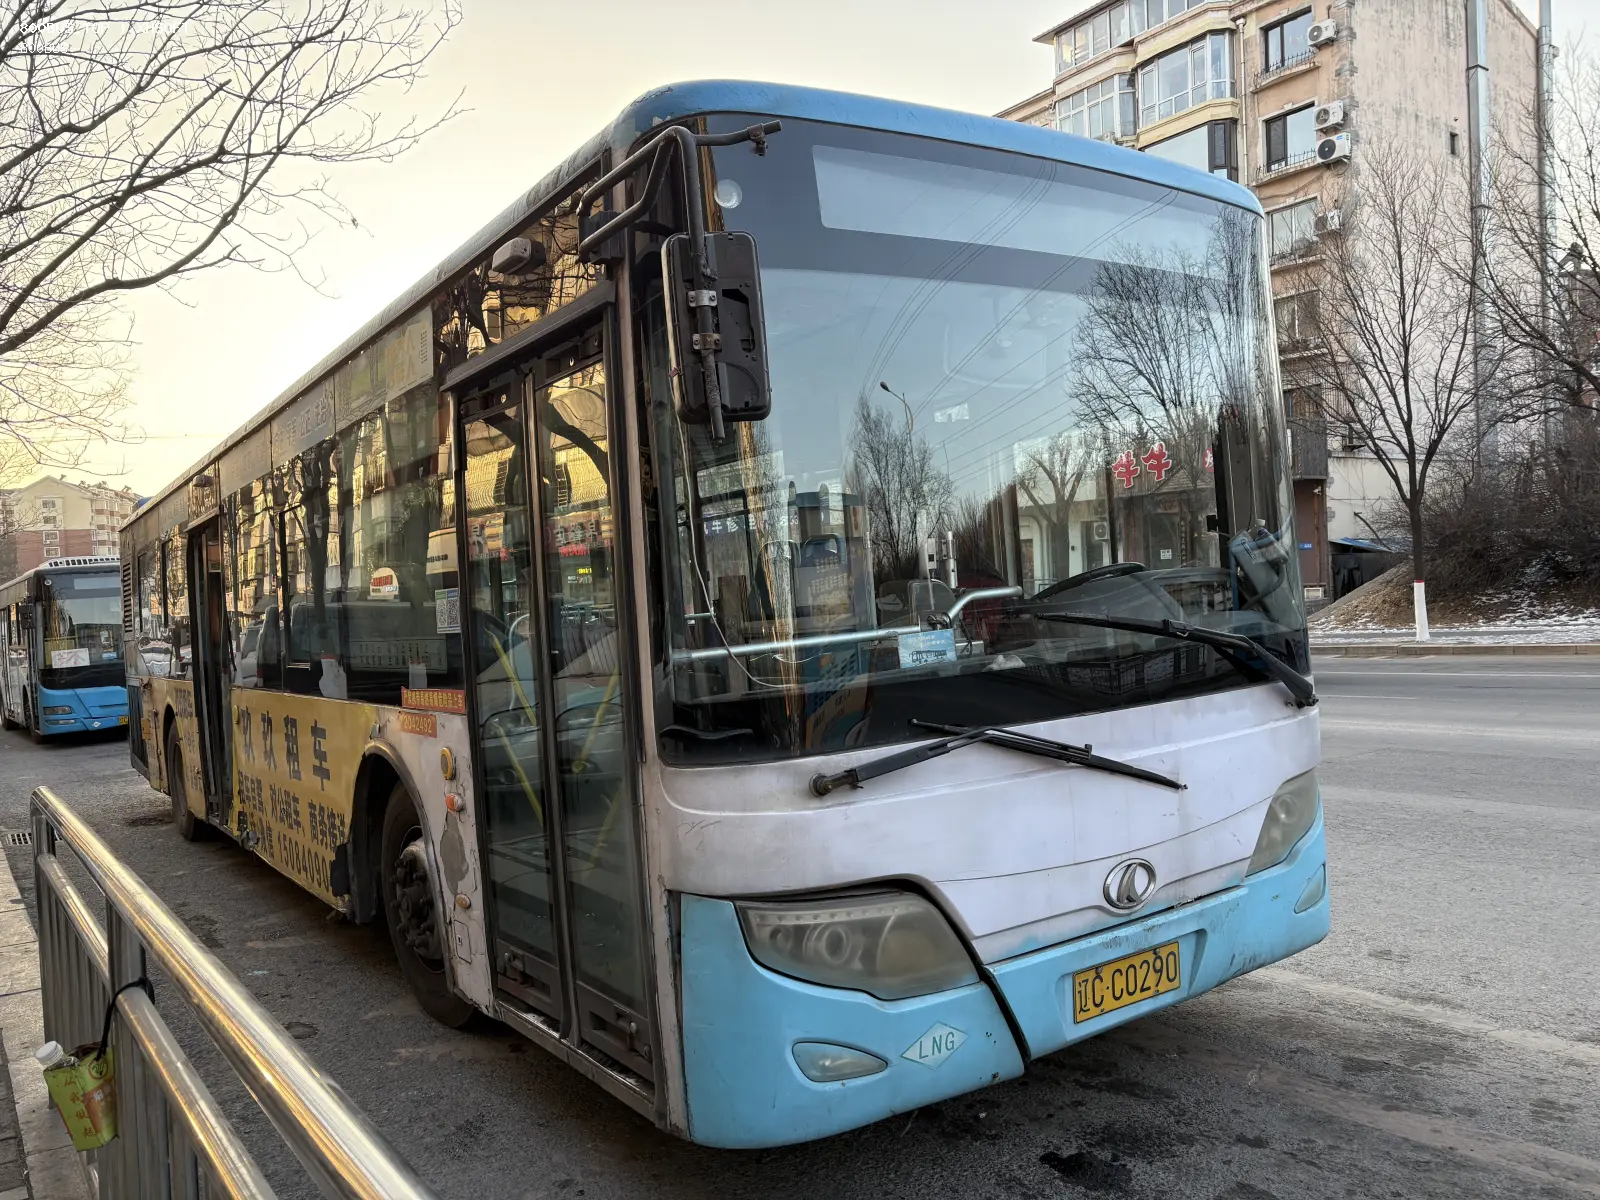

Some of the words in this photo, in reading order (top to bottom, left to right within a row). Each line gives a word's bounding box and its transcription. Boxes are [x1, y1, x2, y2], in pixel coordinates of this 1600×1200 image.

[703, 513, 757, 535] 车修理
[403, 714, 432, 734] 2042492
[277, 831, 331, 893] 15084090
[918, 1031, 956, 1060] LNG
